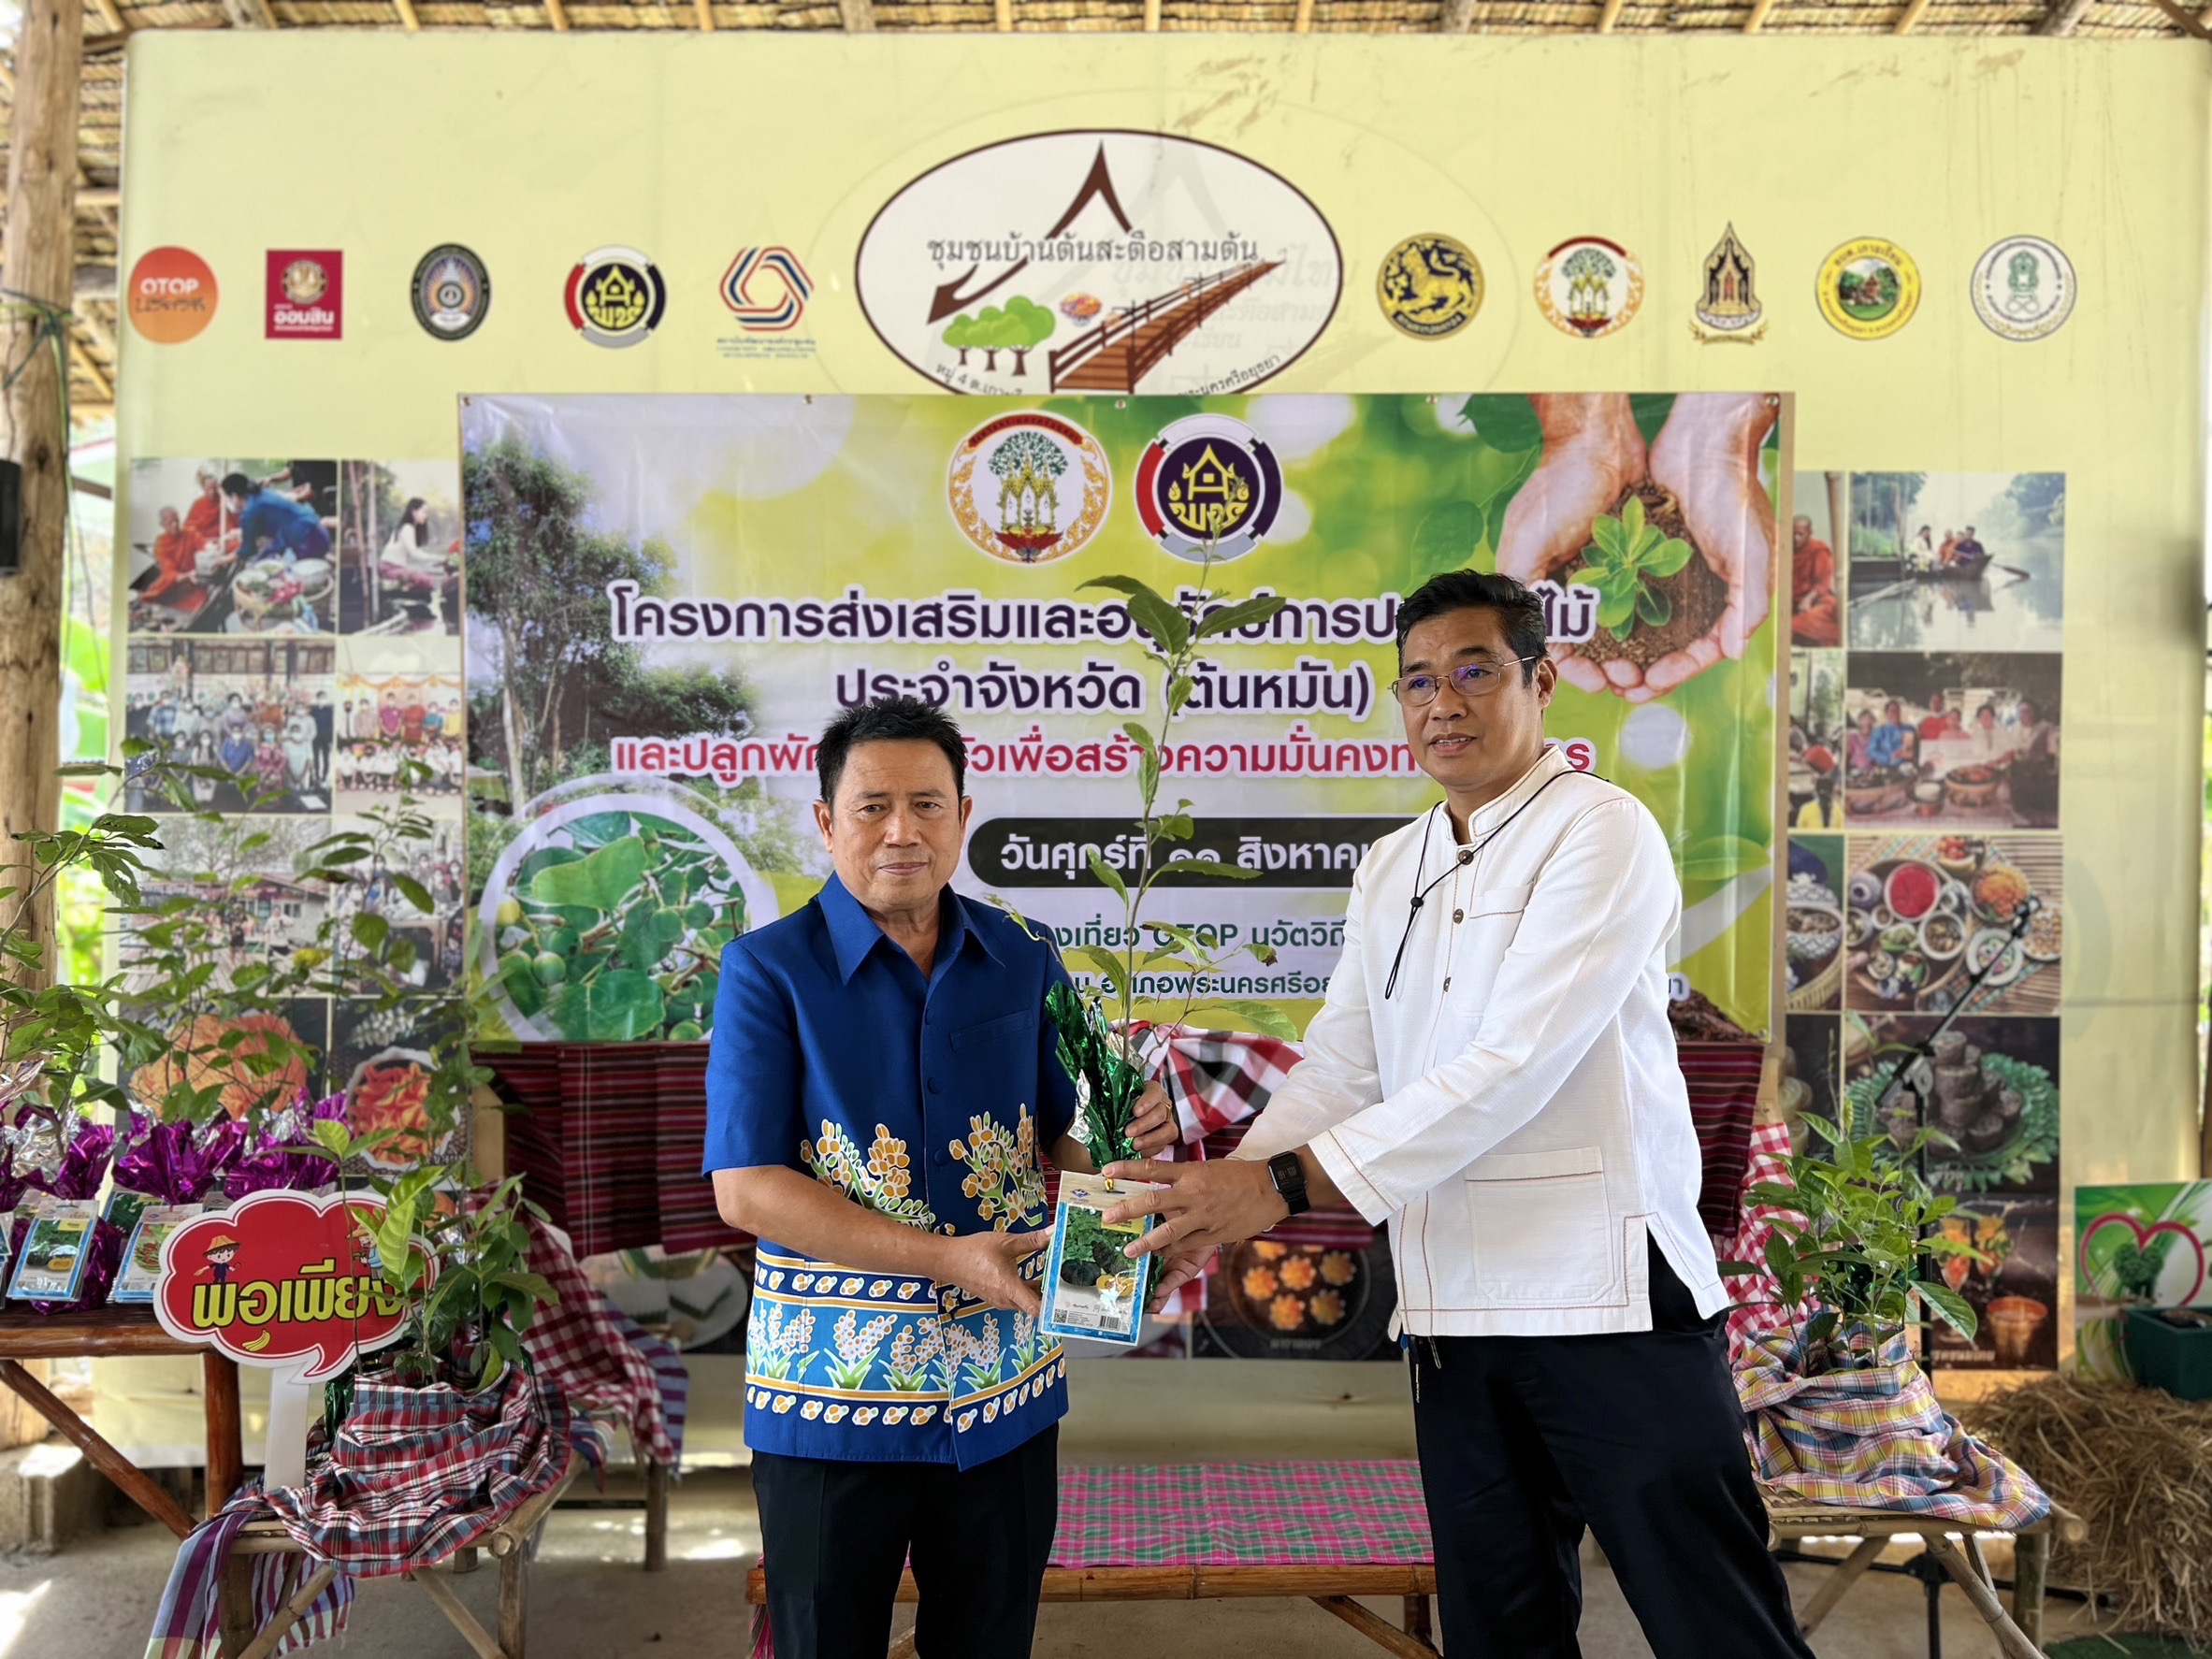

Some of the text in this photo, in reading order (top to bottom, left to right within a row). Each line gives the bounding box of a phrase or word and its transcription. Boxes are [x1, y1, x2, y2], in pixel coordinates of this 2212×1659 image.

[140, 278, 199, 296] OTOP
[837, 660, 1141, 709] ประจำจังหวัด
[1001, 829, 1151, 880] วันศุกร์ที
[1054, 914, 1141, 946] งเที่ยว
[192, 1258, 405, 1328] พอเพียง
